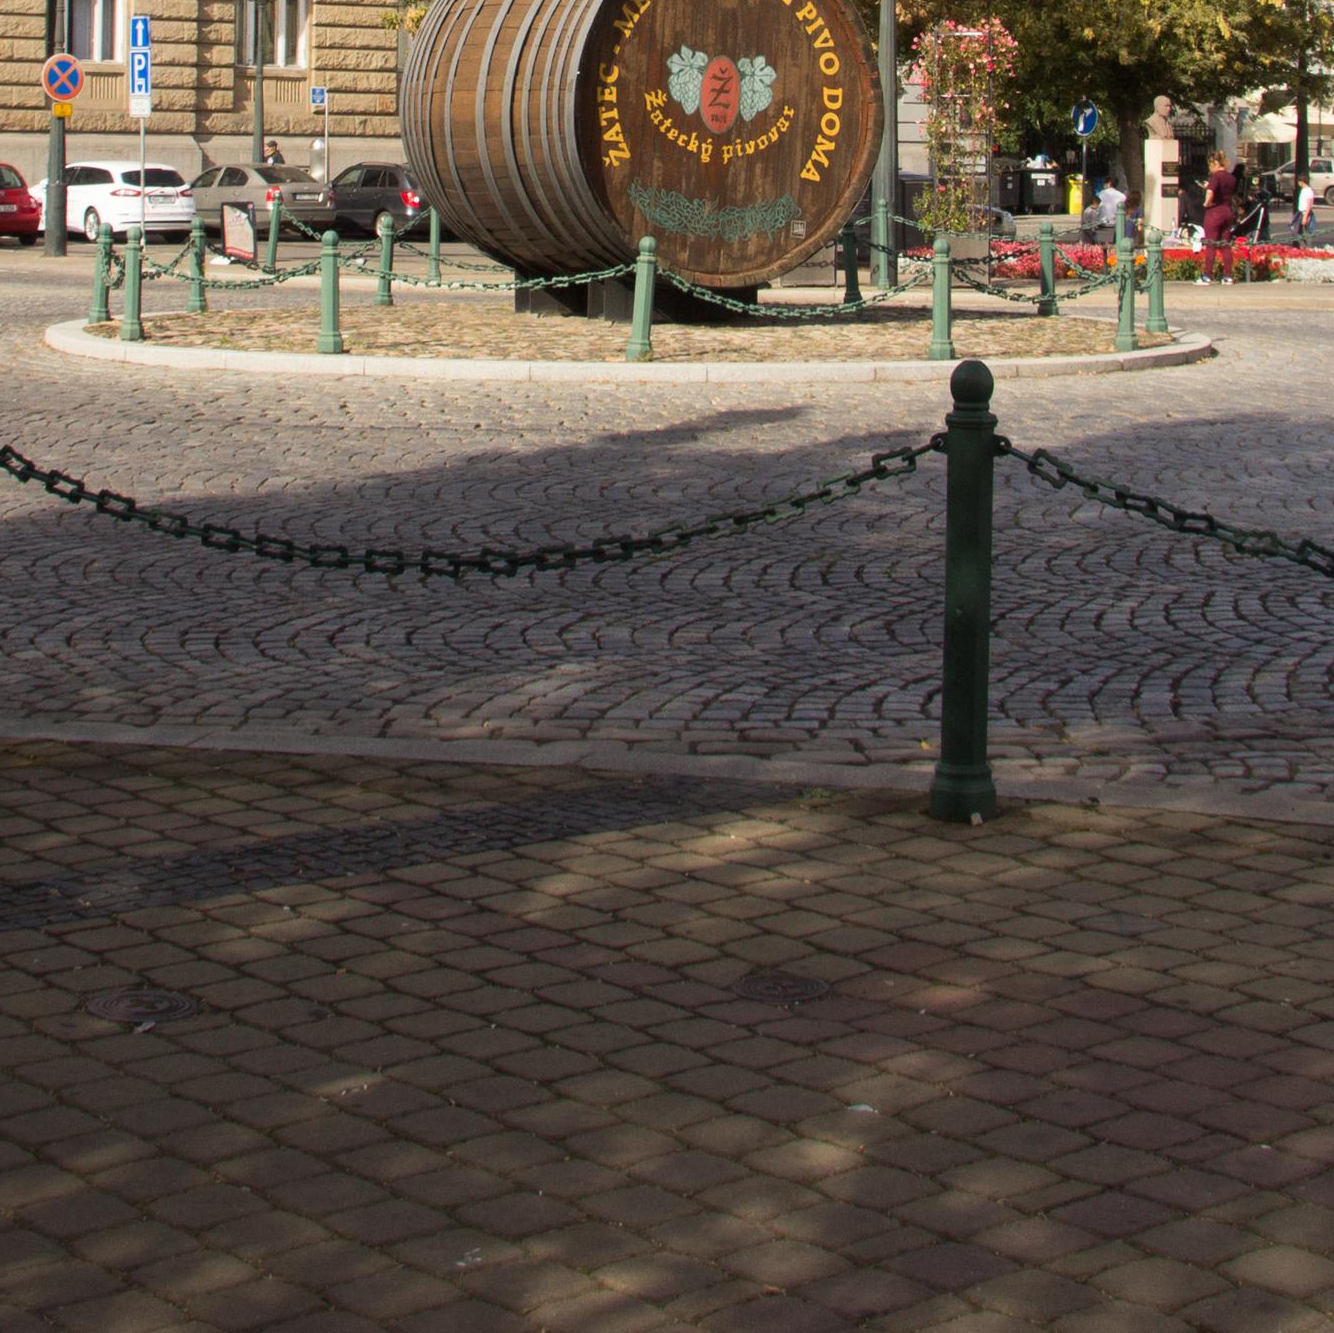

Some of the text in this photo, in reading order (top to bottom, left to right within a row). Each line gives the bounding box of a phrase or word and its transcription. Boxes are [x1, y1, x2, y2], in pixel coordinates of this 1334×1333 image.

[796, 1, 840, 76] PIVO
[597, 63, 631, 167] ŽATEC
[708, 67, 733, 109] Ž
[645, 89, 713, 163] Žatecký
[800, 87, 843, 183] DOMA
